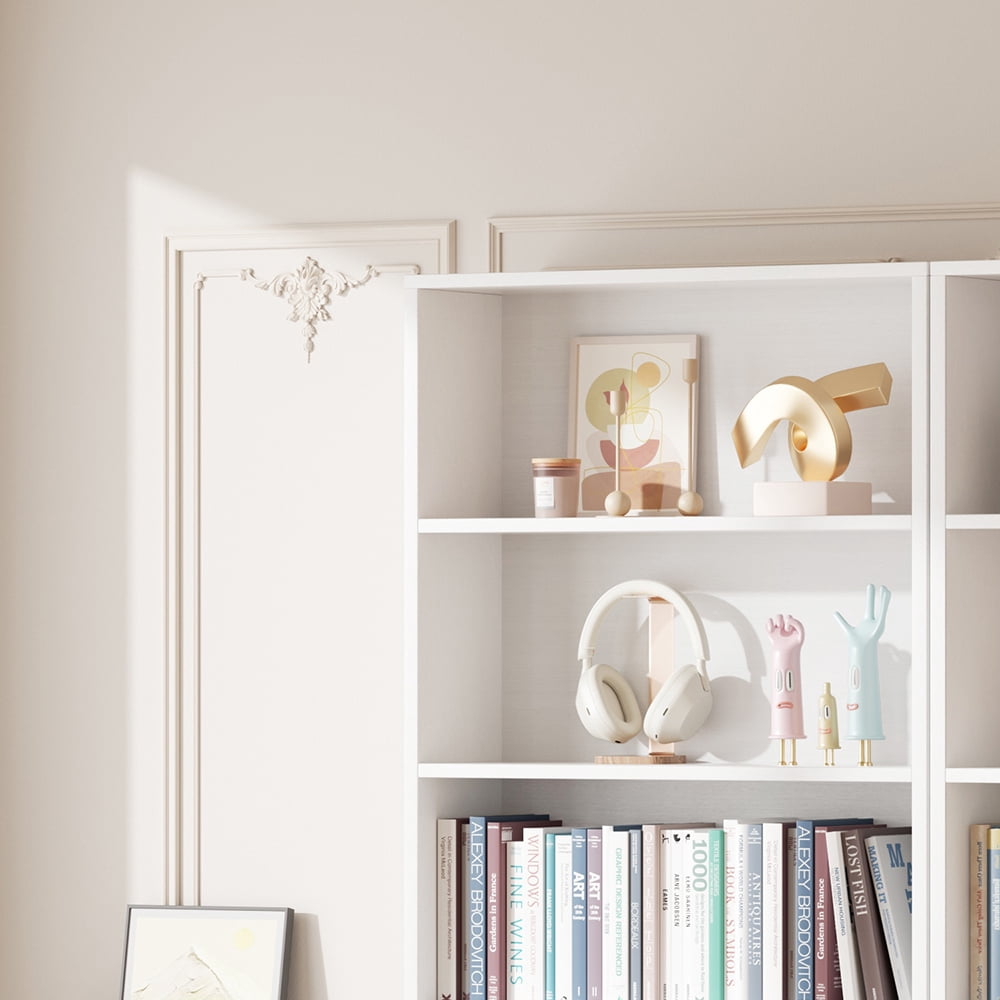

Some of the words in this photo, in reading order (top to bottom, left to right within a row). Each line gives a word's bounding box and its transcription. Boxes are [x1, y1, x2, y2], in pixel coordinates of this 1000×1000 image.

[470, 821, 484, 885] ALEXEY
[527, 834, 540, 908] WINDOWS
[692, 839, 708, 892] 1000
[797, 825, 811, 891] ALEXEY
[844, 835, 860, 879] LOST
[868, 845, 884, 891] MAKING
[878, 893, 887, 904] IT
[489, 873, 497, 903] France
[510, 865, 523, 909] FINE
[573, 872, 585, 900] ART
[588, 872, 601, 900] ART
[726, 865, 736, 904] BOOK
[817, 878, 826, 909] France
[851, 880, 868, 917] FISH
[489, 905, 497, 915] in
[631, 902, 640, 949] BORDEAUX
[752, 873, 761, 966] ANTIQUAIRES
[817, 910, 826, 920] in
[470, 890, 484, 994] BRODOVITCH
[489, 917, 497, 952] Gardens
[510, 919, 523, 985] WINES
[726, 919, 736, 987] SYMBOLS
[817, 922, 826, 960] Gardens
